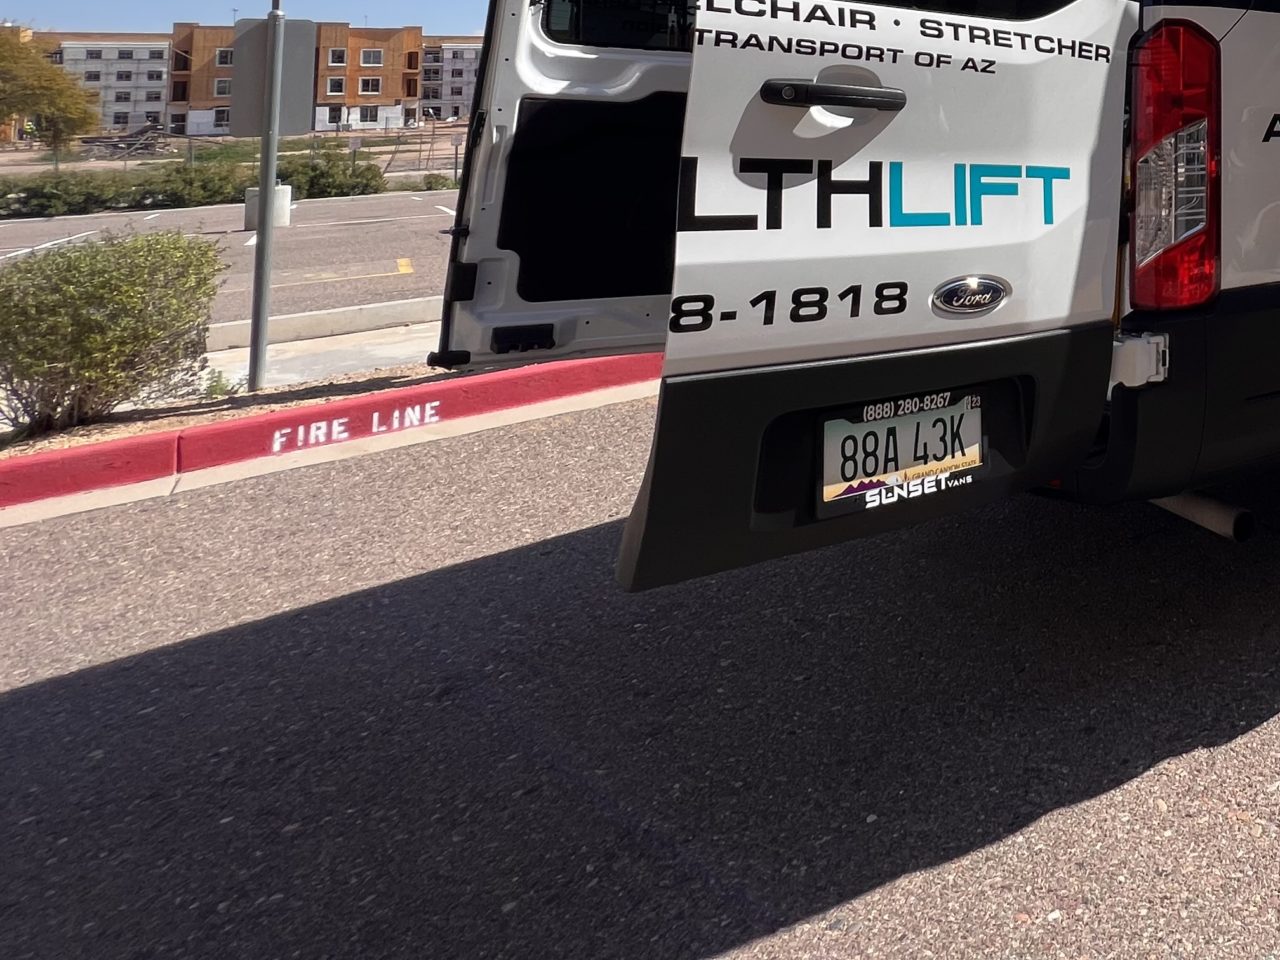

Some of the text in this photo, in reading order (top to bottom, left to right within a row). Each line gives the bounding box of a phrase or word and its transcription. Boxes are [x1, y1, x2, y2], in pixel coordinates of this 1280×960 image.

[695, 28, 997, 74] TRANSPORT OF AZ
[919, 18, 1111, 64] STRETCHER
[668, 281, 909, 334] 8-1818
[952, 285, 993, 307] Ford
[272, 400, 441, 453] FIRE LINE
[863, 391, 951, 423] (888) 280-8267
[840, 412, 966, 483] 88A 43K
[912, 459, 977, 480] GRAND CANYON STATE
[865, 474, 973, 509] SUNSET VANS
